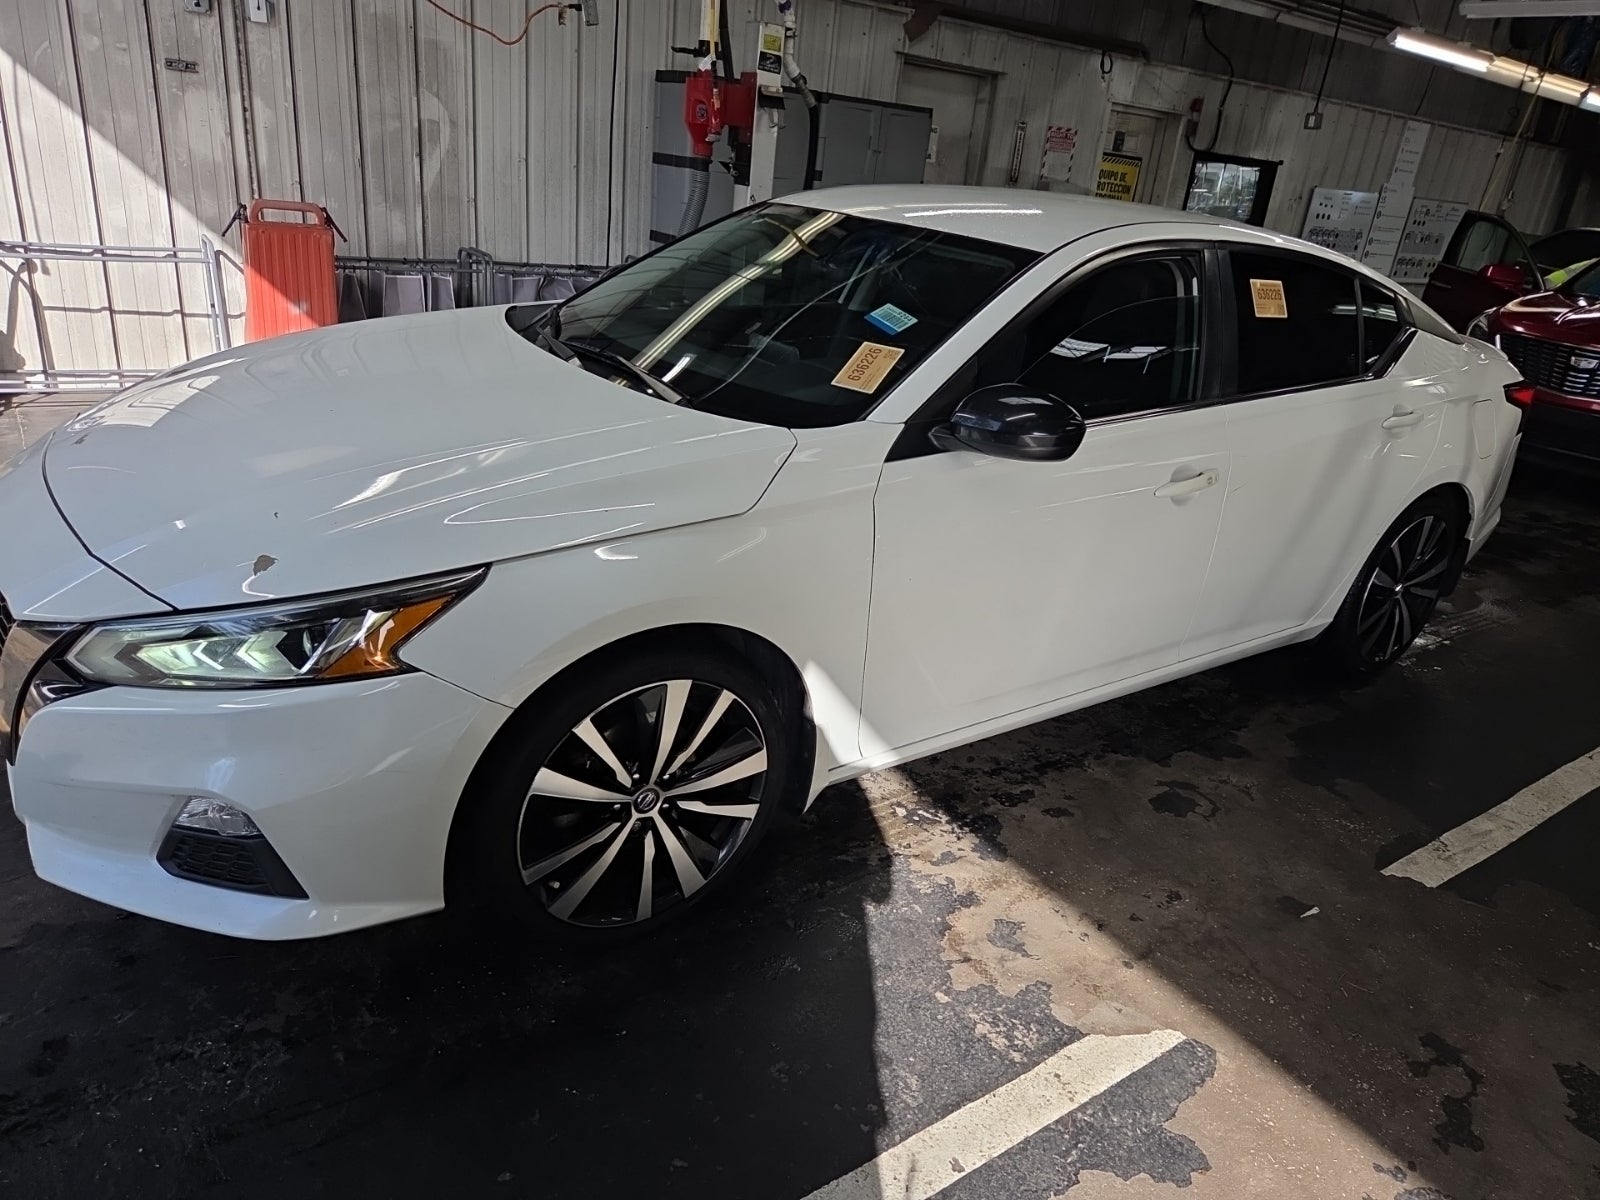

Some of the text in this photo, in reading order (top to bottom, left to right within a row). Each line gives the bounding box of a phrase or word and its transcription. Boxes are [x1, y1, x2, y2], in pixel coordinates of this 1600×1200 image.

[1098, 168, 1128, 182] QUIPO DE
[1096, 181, 1131, 195] ROTECCION
[1257, 288, 1282, 301] 636226
[847, 347, 883, 382] 636226
